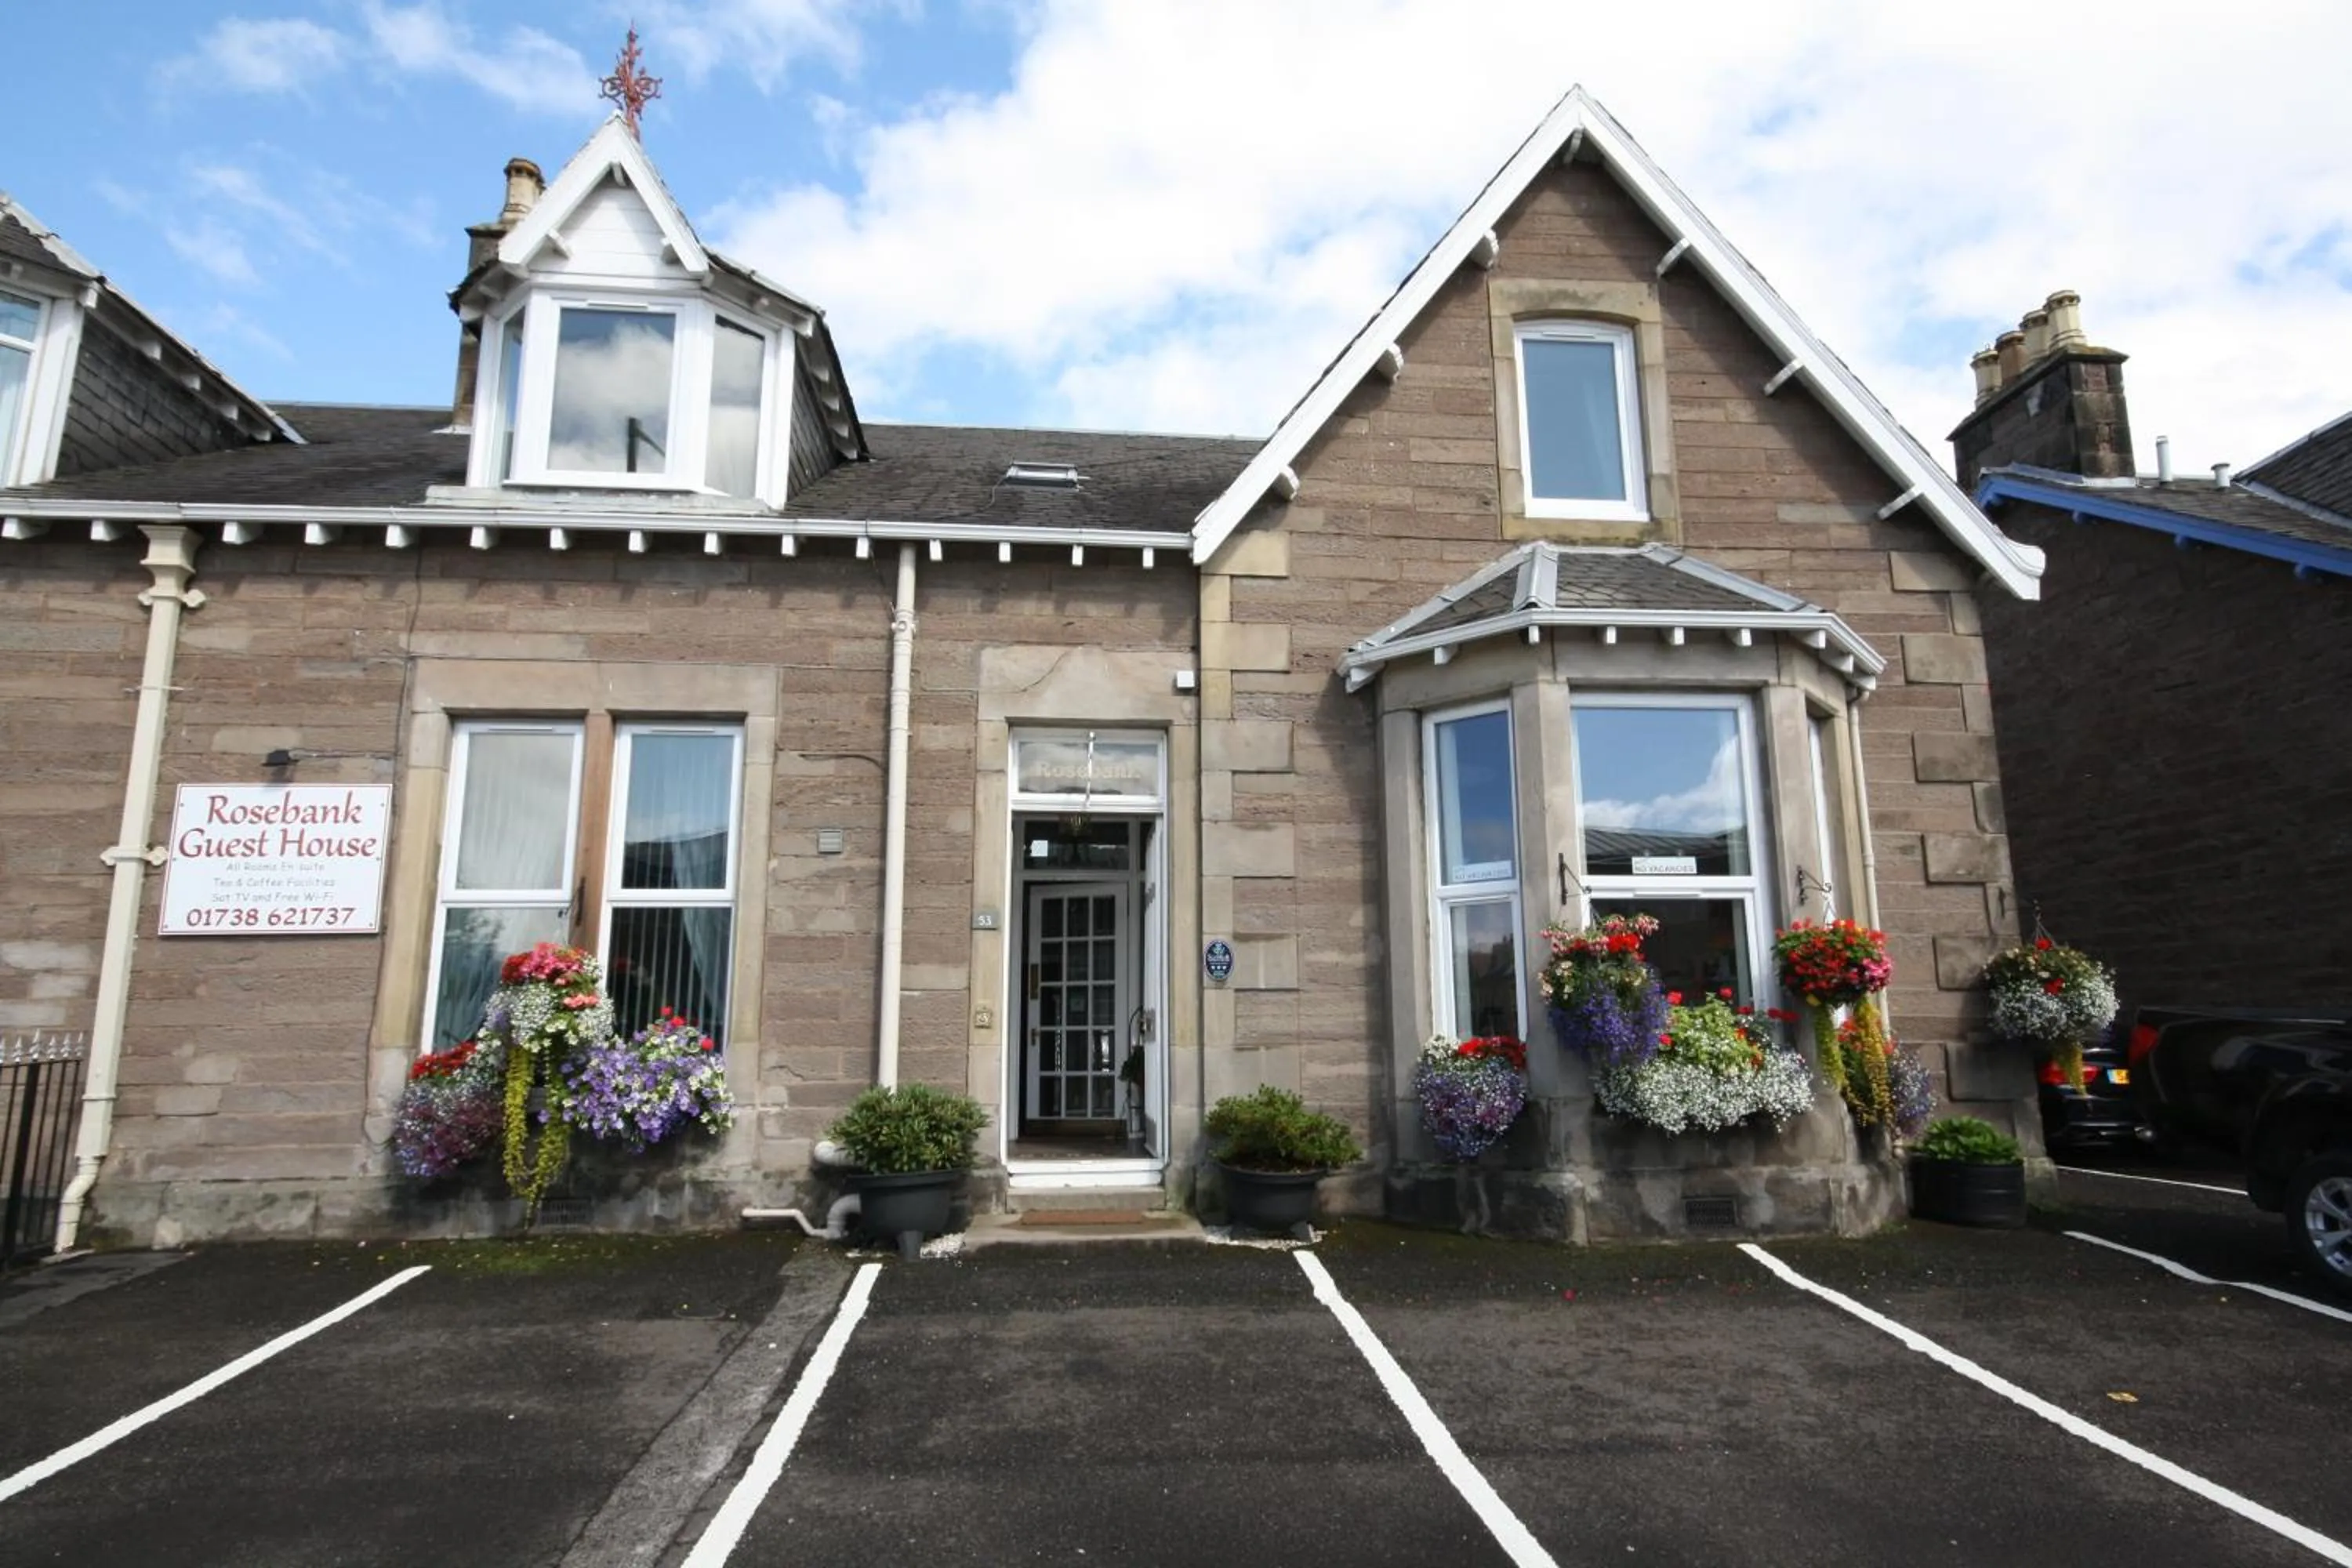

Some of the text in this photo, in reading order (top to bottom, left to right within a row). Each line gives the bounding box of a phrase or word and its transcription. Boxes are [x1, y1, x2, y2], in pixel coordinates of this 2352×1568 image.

[207, 790, 362, 825] Rosebank
[178, 828, 377, 858] Guest House
[226, 862, 240, 872] All
[244, 862, 277, 872] Rooms
[214, 877, 233, 887] Tea
[236, 877, 242, 887] &
[246, 877, 282, 887] Coffee
[212, 892, 230, 902] Sat
[236, 892, 251, 902] TV
[252, 892, 272, 902] and
[275, 892, 299, 902] Free
[186, 907, 356, 927] 01738 621737
